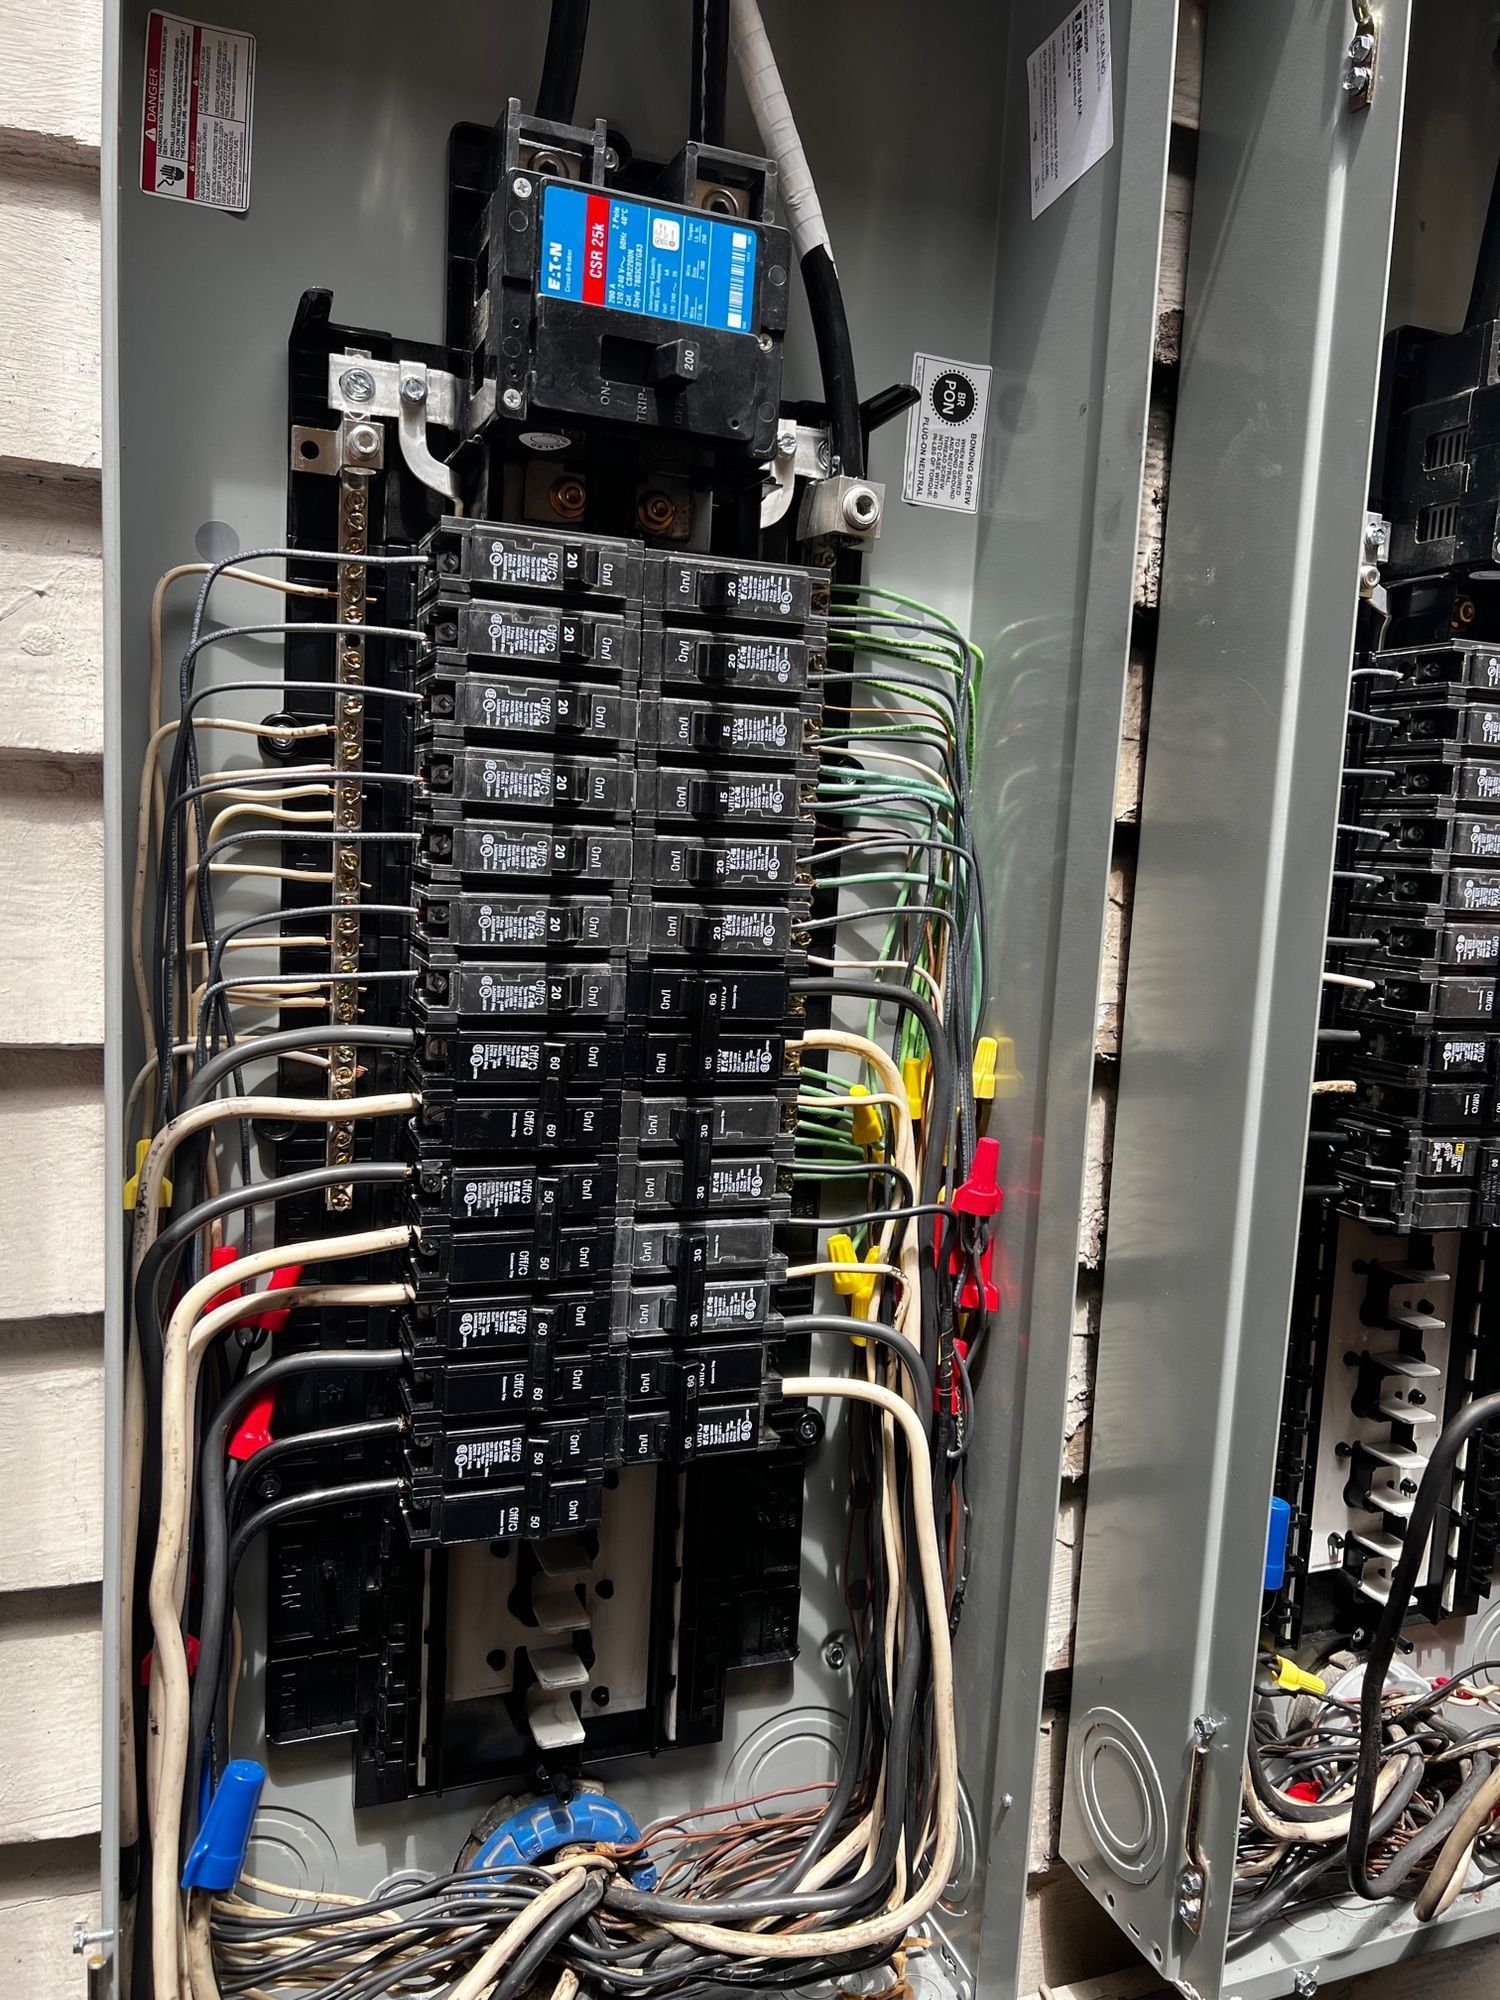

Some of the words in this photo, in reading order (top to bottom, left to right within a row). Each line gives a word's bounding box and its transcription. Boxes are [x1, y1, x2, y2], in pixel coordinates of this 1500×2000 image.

[147, 68, 158, 122] DANGER
[612, 206, 620, 223] Pole
[592, 223, 604, 247] 25k
[590, 250, 603, 278] CSR
[617, 275, 625, 304] 120/240
[684, 349, 695, 371] 200
[942, 380, 957, 415] PON
[957, 392, 966, 407] BR
[920, 417, 930, 455] PLUG-ON
[955, 438, 960, 447] TO
[967, 433, 977, 472] BONDING
[930, 457, 935, 467] OF
[917, 457, 926, 496] NEUTRAL
[956, 460, 964, 496] REQUIRED
[933, 490, 938, 499] 40
[964, 474, 973, 505] SCREW
[567, 553, 578, 568] 20
[728, 582, 736, 597] 20
[564, 627, 574, 642] 20
[728, 654, 736, 668] 20
[558, 700, 568, 715] 20
[723, 726, 730, 737] 15
[557, 775, 567, 790] 20
[720, 792, 728, 802] 15
[555, 845, 566, 859] 20
[716, 860, 724, 874] 20
[550, 918, 561, 932] 20
[713, 926, 721, 940] 20
[551, 986, 562, 1000] 20
[550, 1057, 560, 1070] 60
[546, 1124, 556, 1137] 60
[700, 1124, 709, 1137] 30
[544, 1190, 554, 1203] 50
[697, 1186, 705, 1199] 30
[694, 1248, 702, 1261] 30
[540, 1257, 549, 1270] 50
[690, 1314, 699, 1327] 30
[538, 1323, 548, 1336] 60
[533, 1388, 543, 1400] 60
[534, 1452, 544, 1465] 50
[530, 1516, 540, 1528] 50
